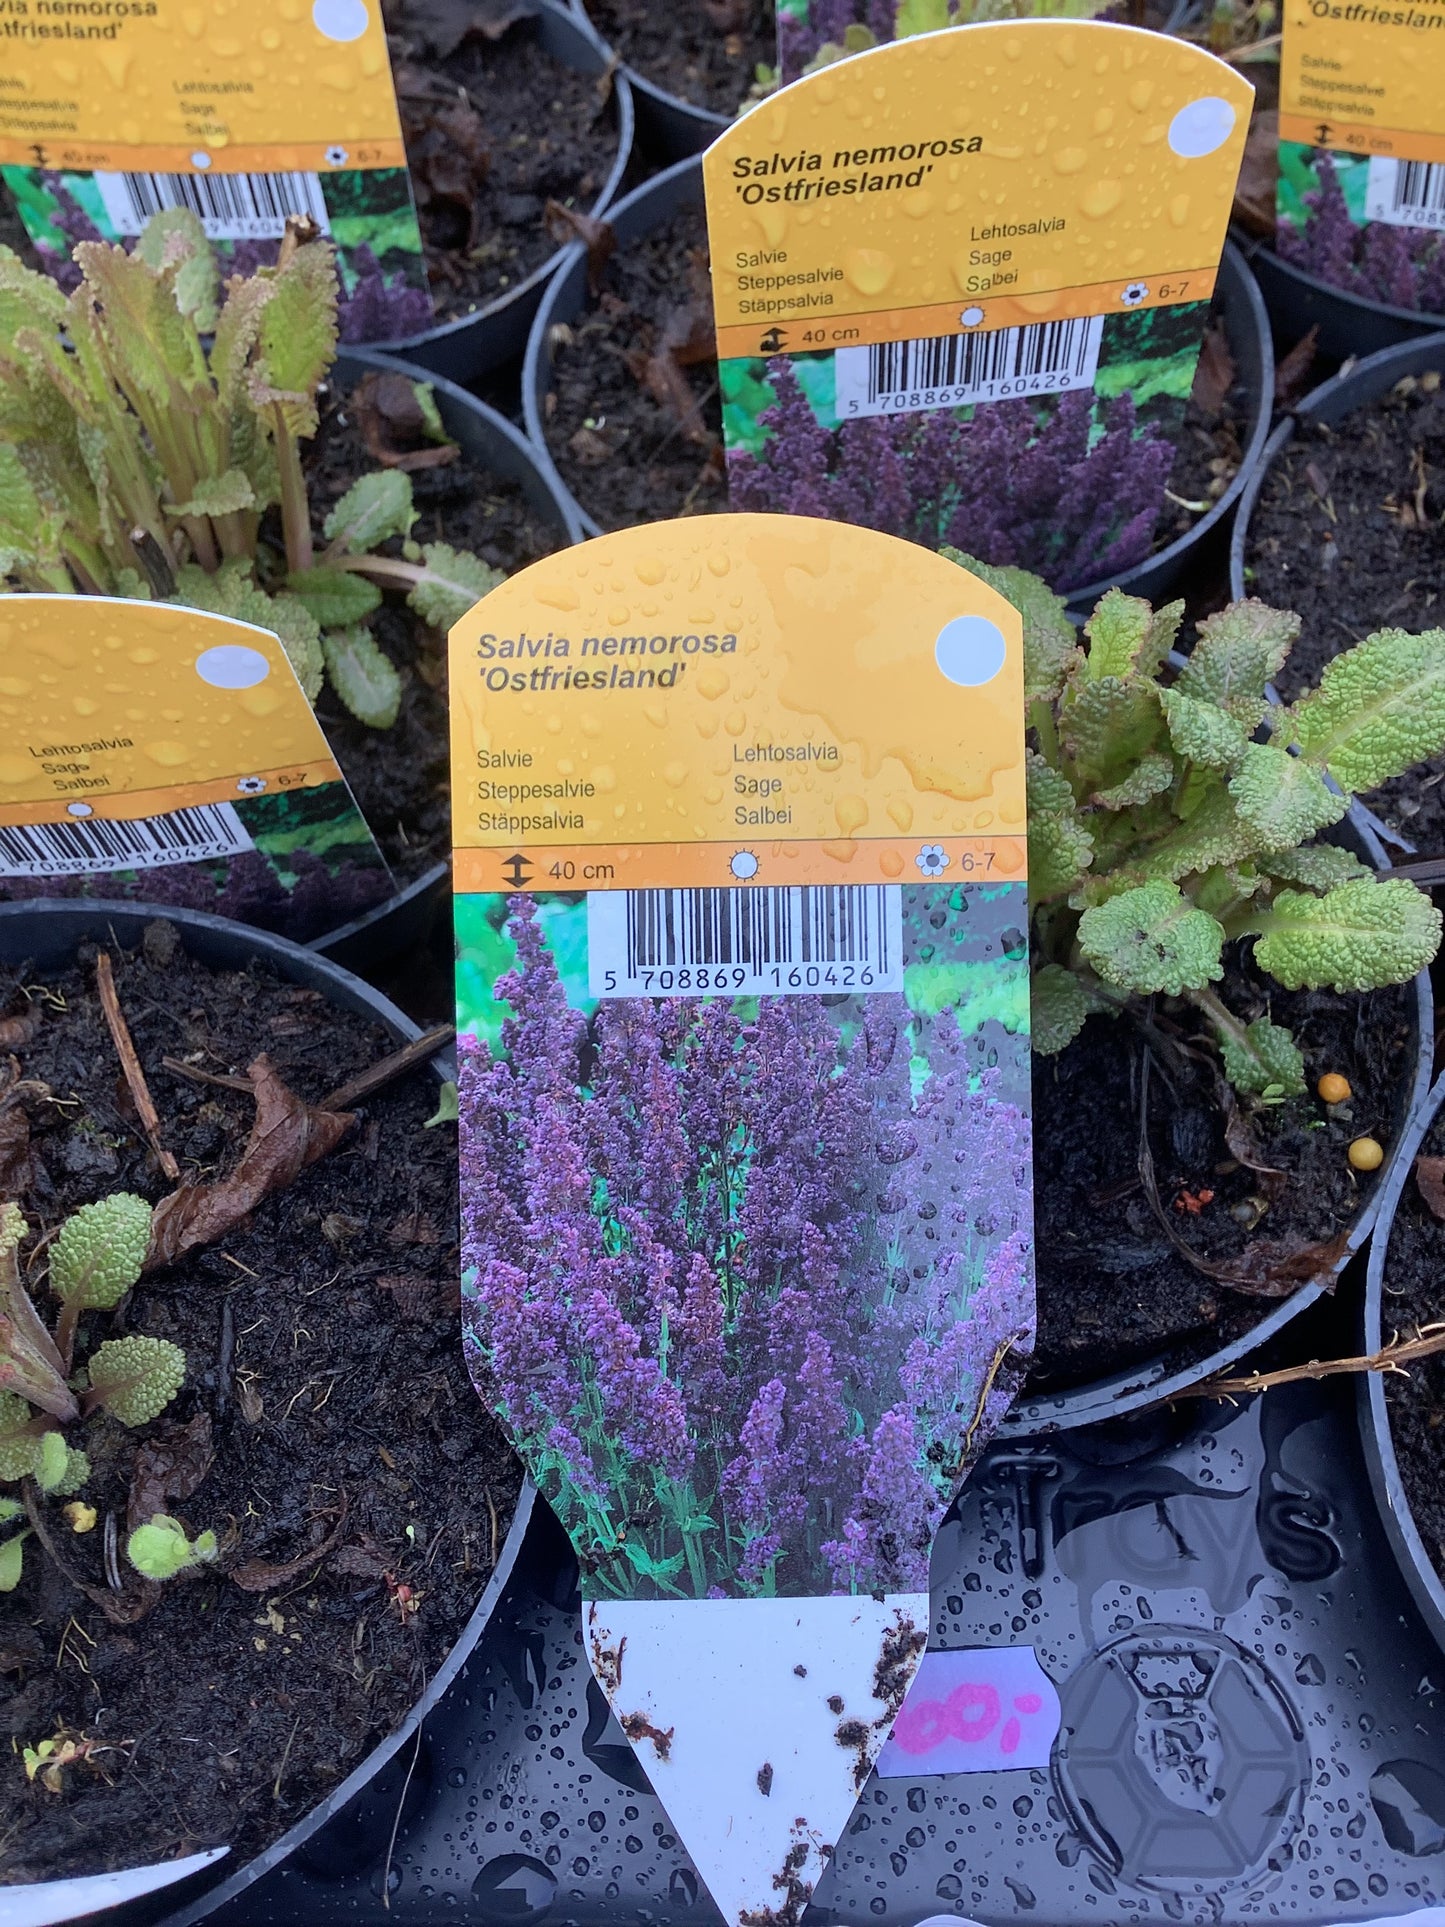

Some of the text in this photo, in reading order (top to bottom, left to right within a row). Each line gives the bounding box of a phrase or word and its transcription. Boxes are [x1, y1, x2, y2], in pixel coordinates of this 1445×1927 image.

[0, 20, 122, 39] tfriesland'
[733, 135, 983, 178] Salvia nemorosa
[736, 164, 934, 205] 'Ostfriesland'
[970, 218, 1066, 242] Lehtosalvia
[736, 249, 788, 268] Salvie
[968, 248, 1012, 266] Sage
[738, 266, 844, 292] Steppesalvie
[966, 269, 1018, 293] Salbei
[1158, 282, 1189, 299] 6-7
[739, 291, 834, 315] Stäppsalvia
[802, 326, 860, 343] 40 cm
[849, 371, 1071, 413] 5 708869 160426
[477, 632, 737, 659] Salvia nemorosa
[479, 663, 687, 692] 'Ostfriesland'
[28, 737, 134, 758] Lehtosalvia
[733, 743, 839, 763] Lehtosalvia
[477, 749, 533, 769] Salvie
[53, 775, 111, 791] Salbei
[477, 781, 596, 801] Steppesalvie
[733, 775, 783, 796] Sage
[478, 811, 585, 834] Stäppsalvia
[733, 806, 793, 826] Salbei
[137, 842, 229, 864] 160426
[962, 853, 997, 873] 6-7
[549, 862, 615, 880] 40 cm
[605, 966, 875, 990] 5 708869 160426
